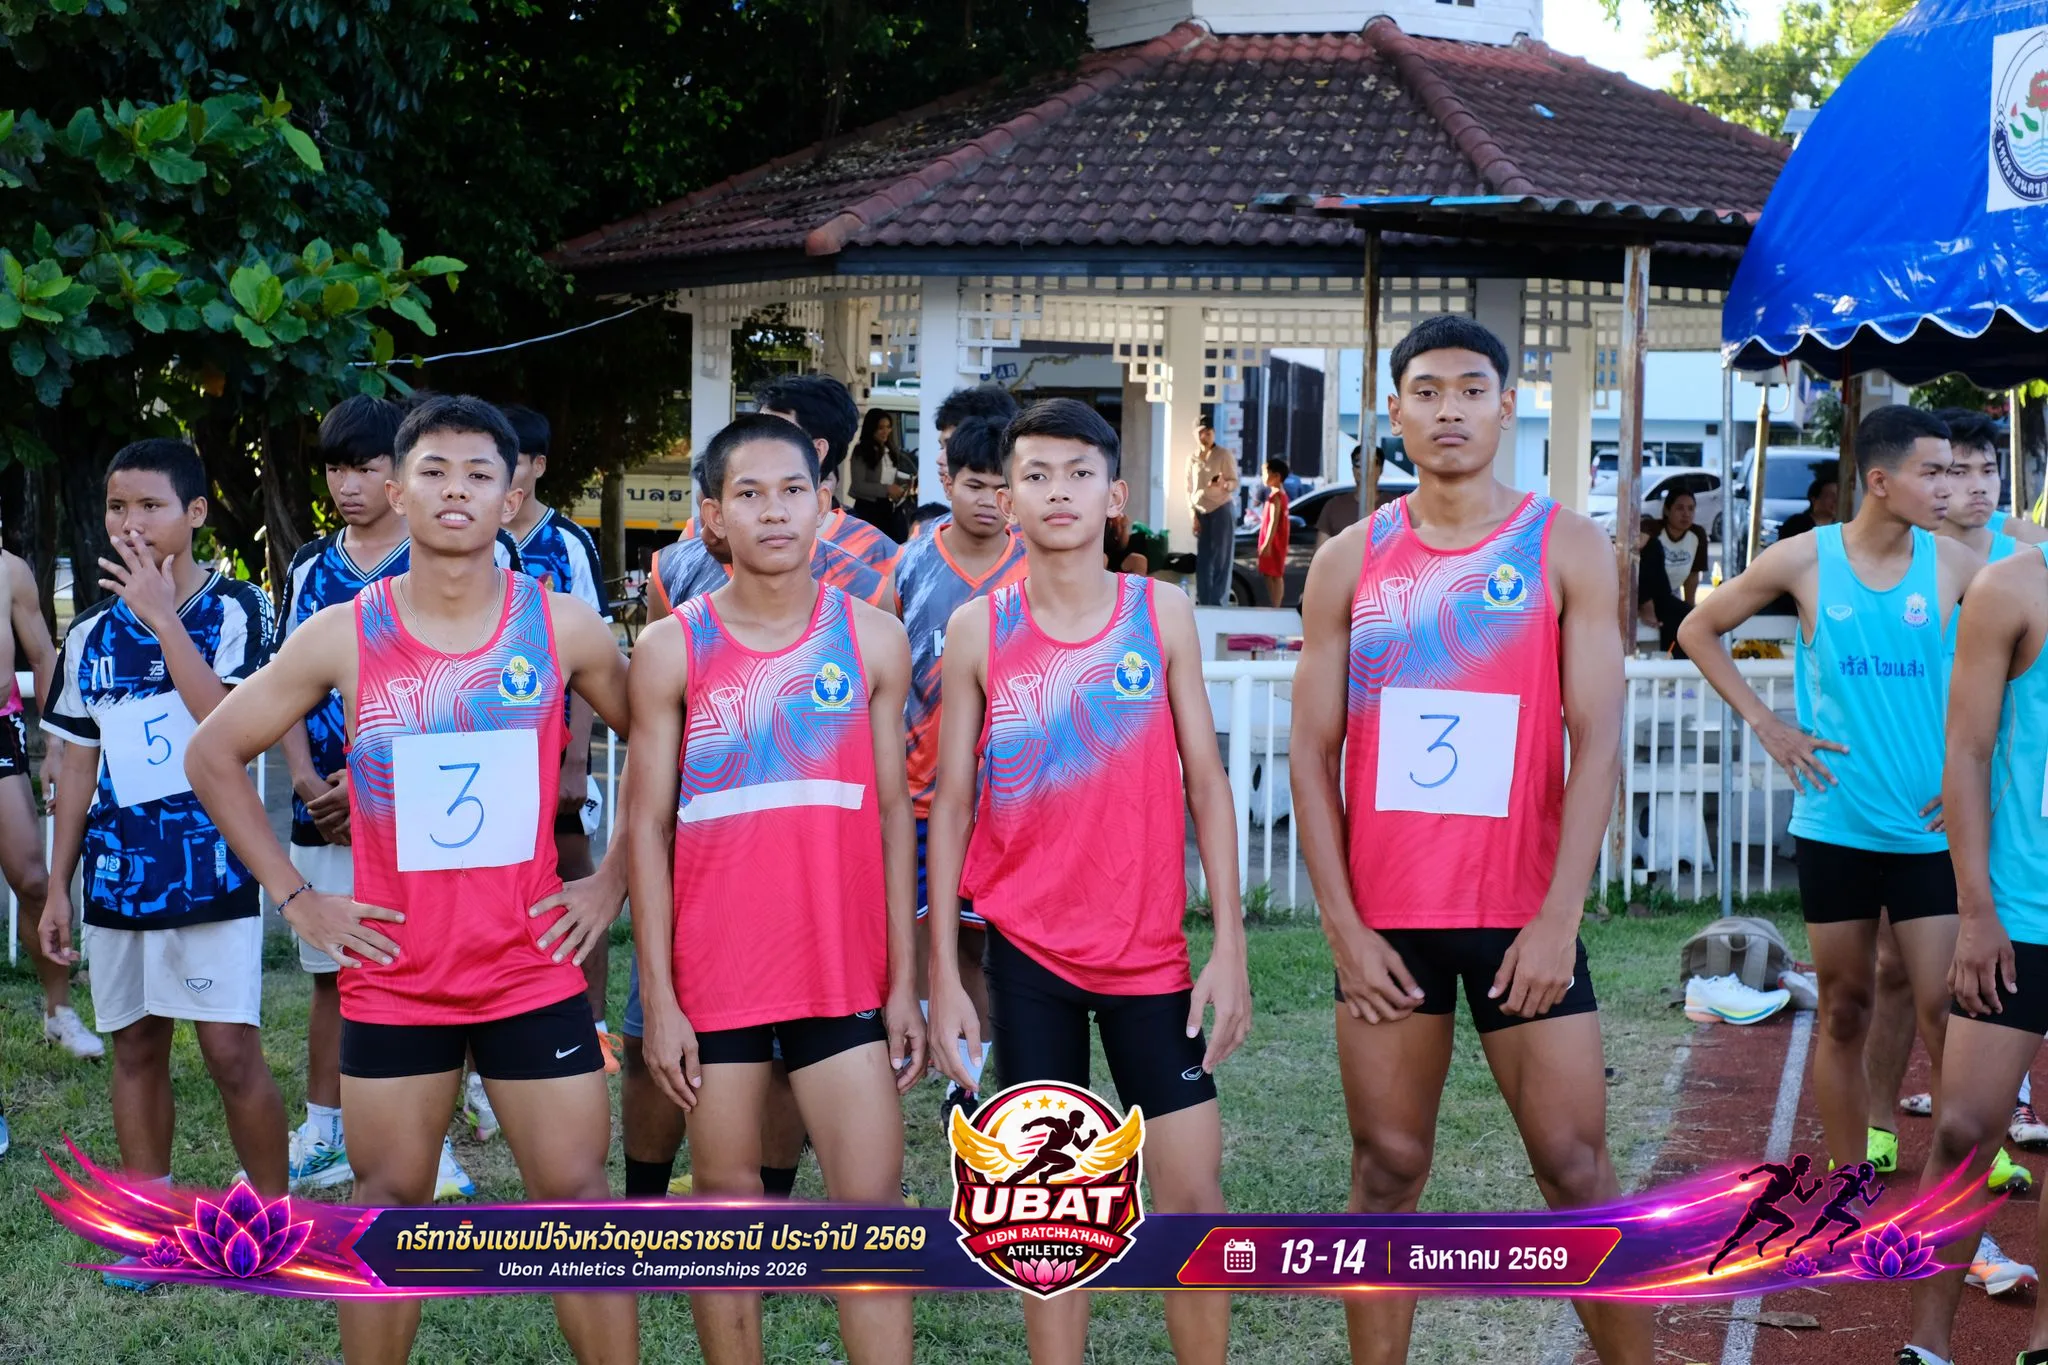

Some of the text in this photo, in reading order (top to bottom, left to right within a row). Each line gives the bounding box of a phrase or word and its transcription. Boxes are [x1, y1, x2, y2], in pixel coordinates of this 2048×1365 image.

[144, 712, 172, 765] 5
[1409, 714, 1460, 788] 3
[429, 762, 485, 849] 3
